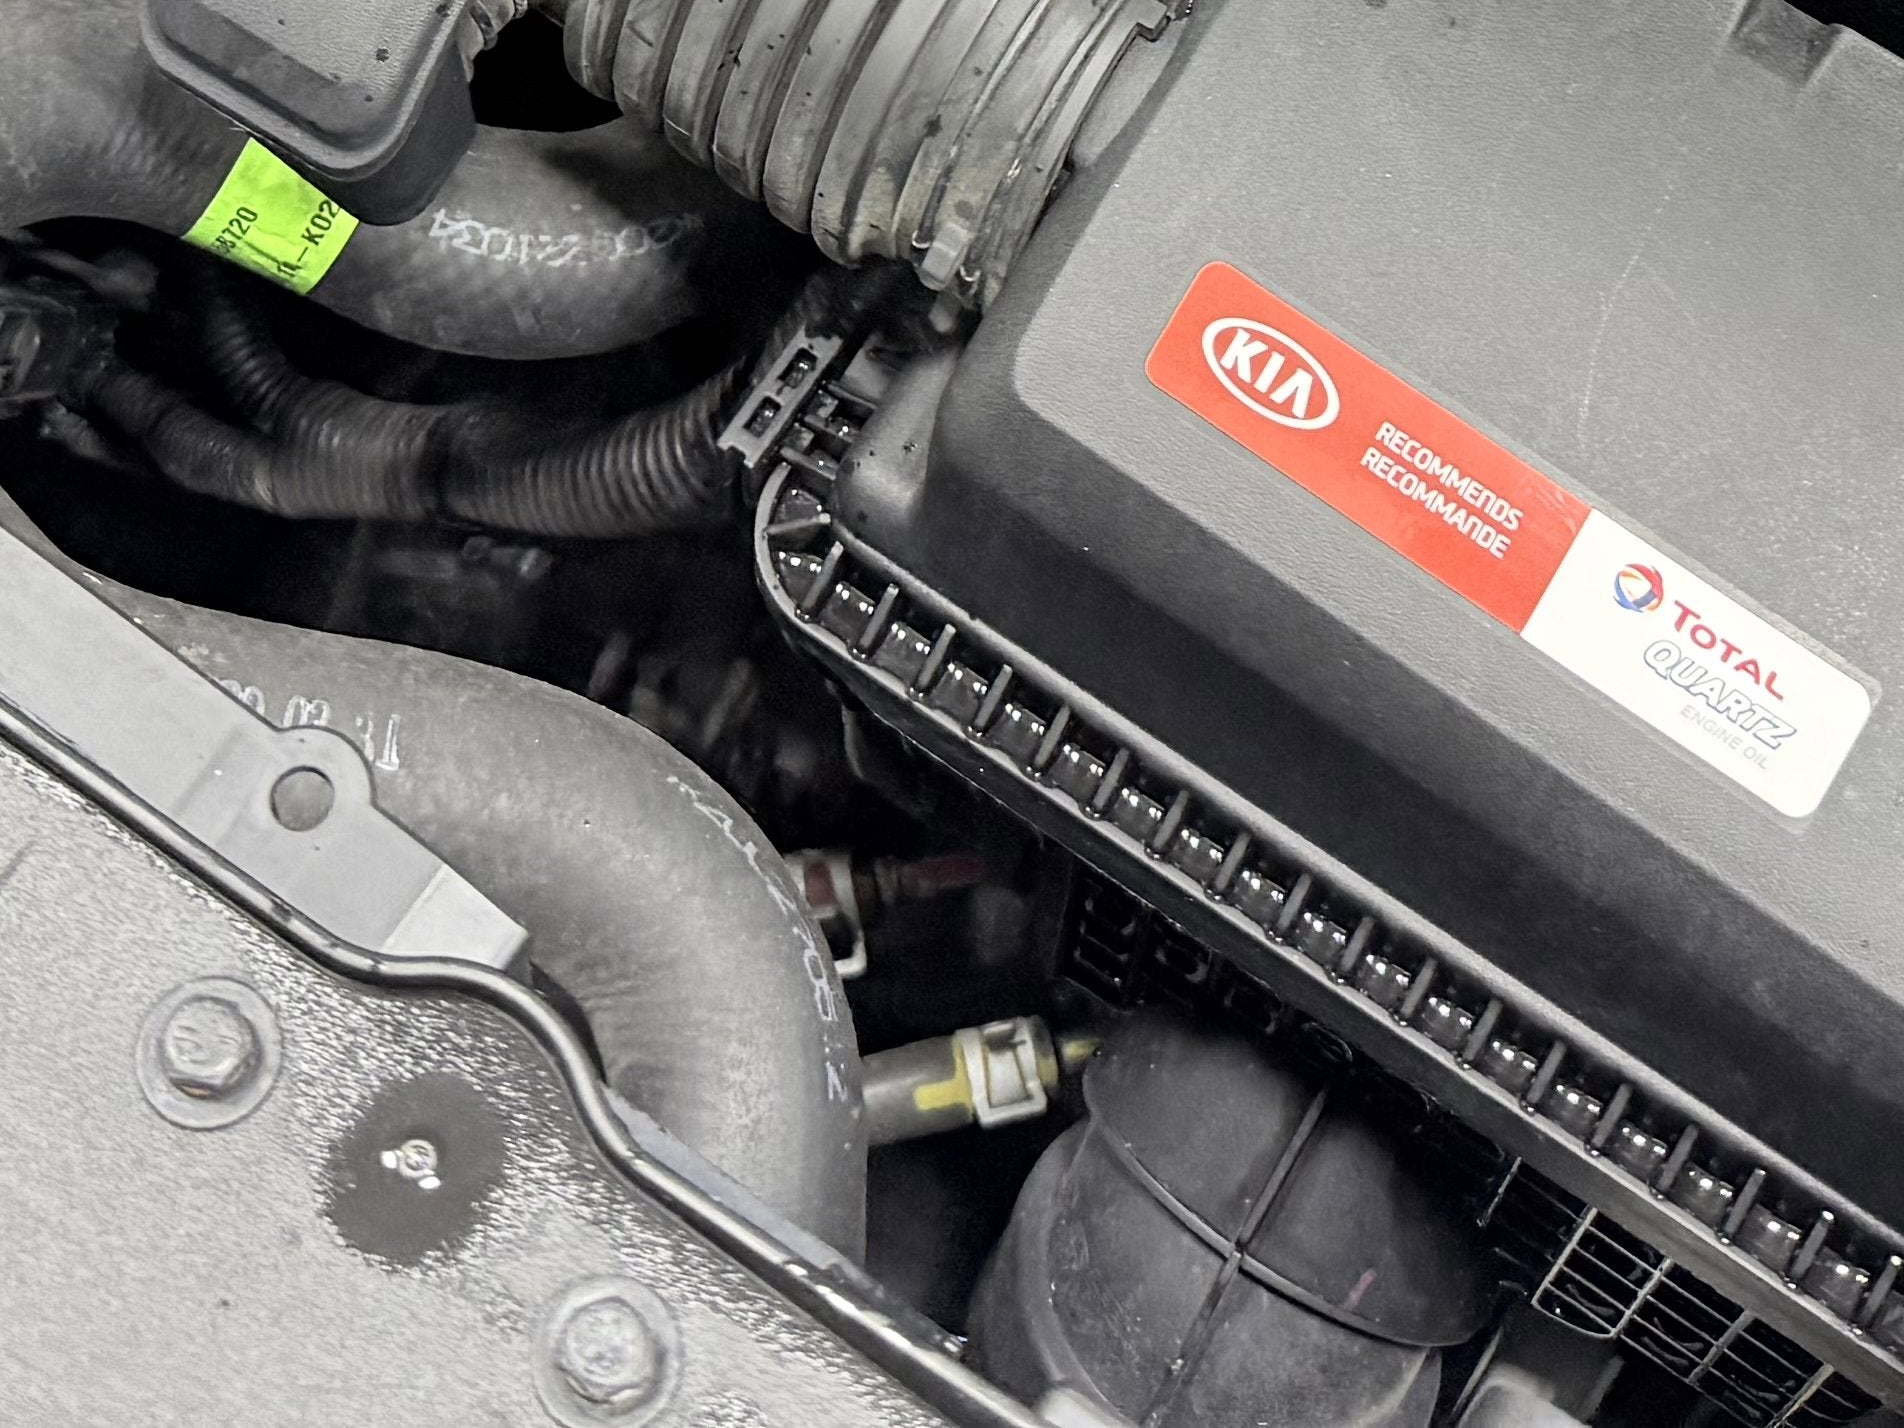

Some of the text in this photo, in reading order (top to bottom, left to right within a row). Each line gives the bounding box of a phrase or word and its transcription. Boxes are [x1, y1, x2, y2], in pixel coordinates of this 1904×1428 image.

[1217, 325, 1325, 420] KIA
[1358, 445, 1513, 560] RECOMMANDE
[1373, 419, 1526, 532] RECOMMENDS
[1643, 638, 1797, 751] QUARTZ
[1668, 600, 1788, 700] TOTAL
[1678, 702, 1772, 770] ENGINE OIL
